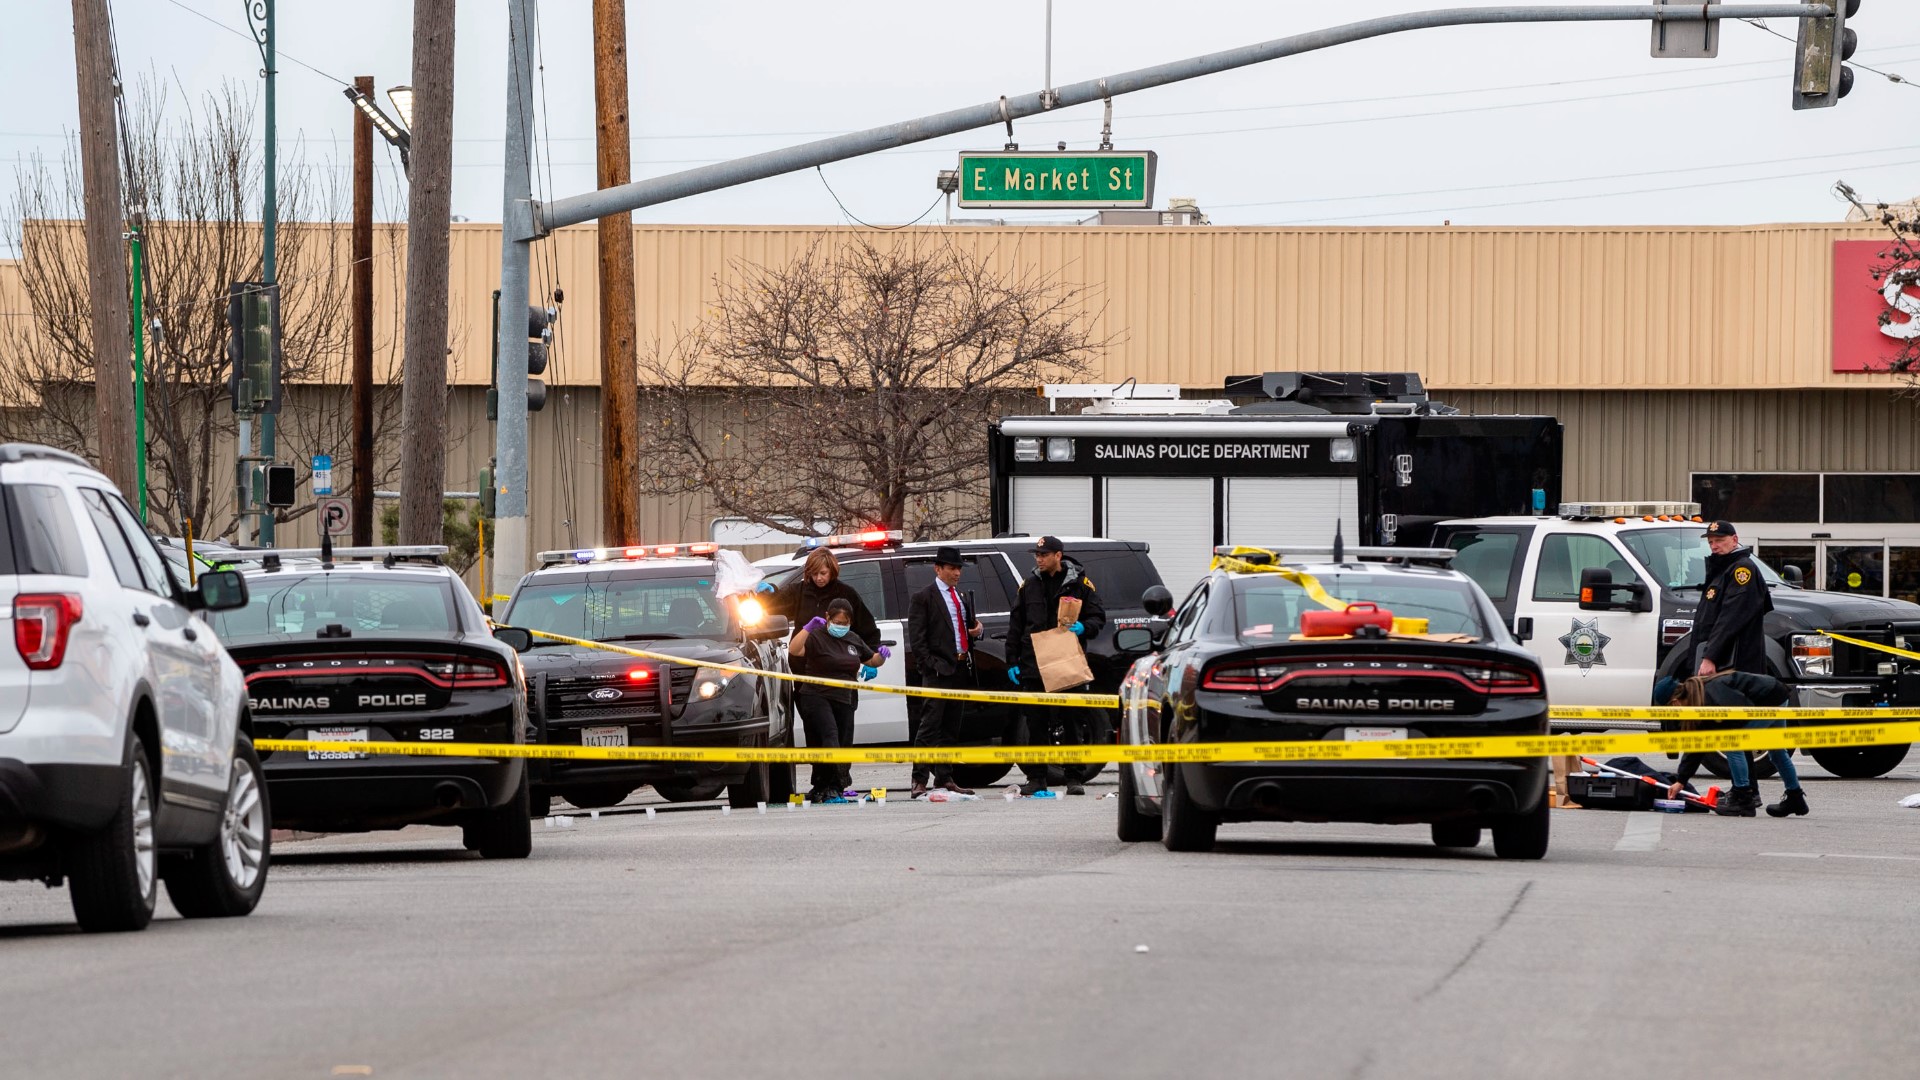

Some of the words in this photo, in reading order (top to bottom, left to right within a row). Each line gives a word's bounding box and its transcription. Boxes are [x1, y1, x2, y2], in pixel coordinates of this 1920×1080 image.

[974, 168, 992, 191] E.
[1005, 168, 1089, 191] Market
[1108, 166, 1132, 191] St
[1095, 444, 1155, 459] SALINAS
[1159, 444, 1210, 459] POLICE
[1214, 444, 1310, 459] DEPARTMENT
[276, 660, 395, 668] DODGE
[249, 697, 330, 709] SALINAS
[358, 694, 426, 707] POLICE
[1296, 698, 1380, 710] SALINAS
[1388, 699, 1455, 710] POLICE
[419, 728, 454, 740] 322
